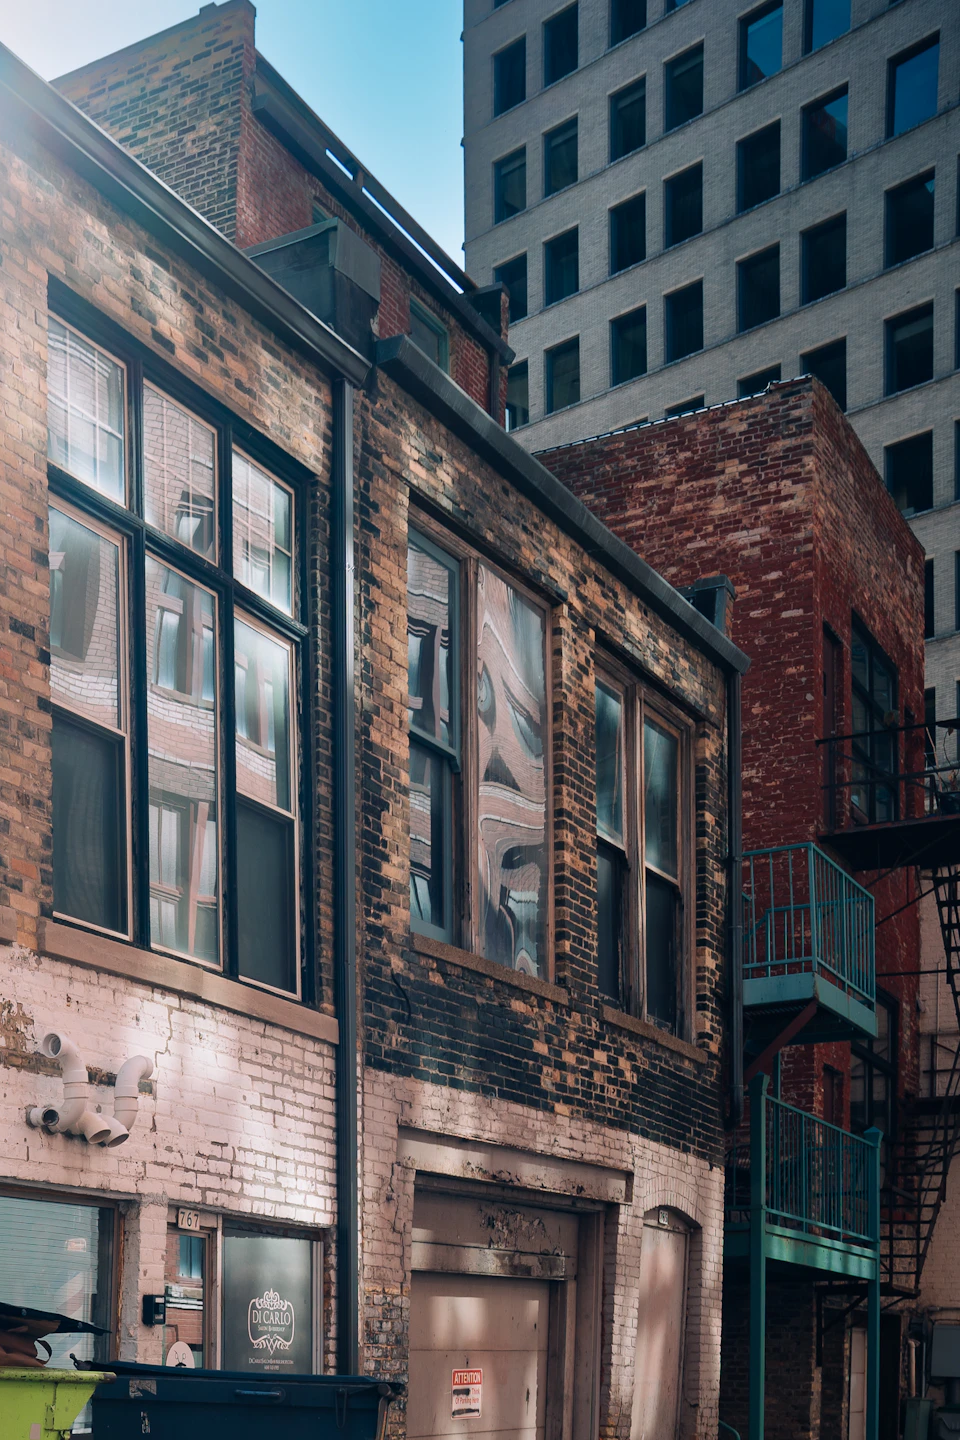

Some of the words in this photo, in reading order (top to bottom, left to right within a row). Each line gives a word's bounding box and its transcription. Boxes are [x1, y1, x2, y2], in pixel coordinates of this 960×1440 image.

[180, 1211, 199, 1228] 767
[252, 1310, 262, 1323] DI
[263, 1310, 291, 1325] CARLO
[454, 1372, 480, 1384] ATTENTION
